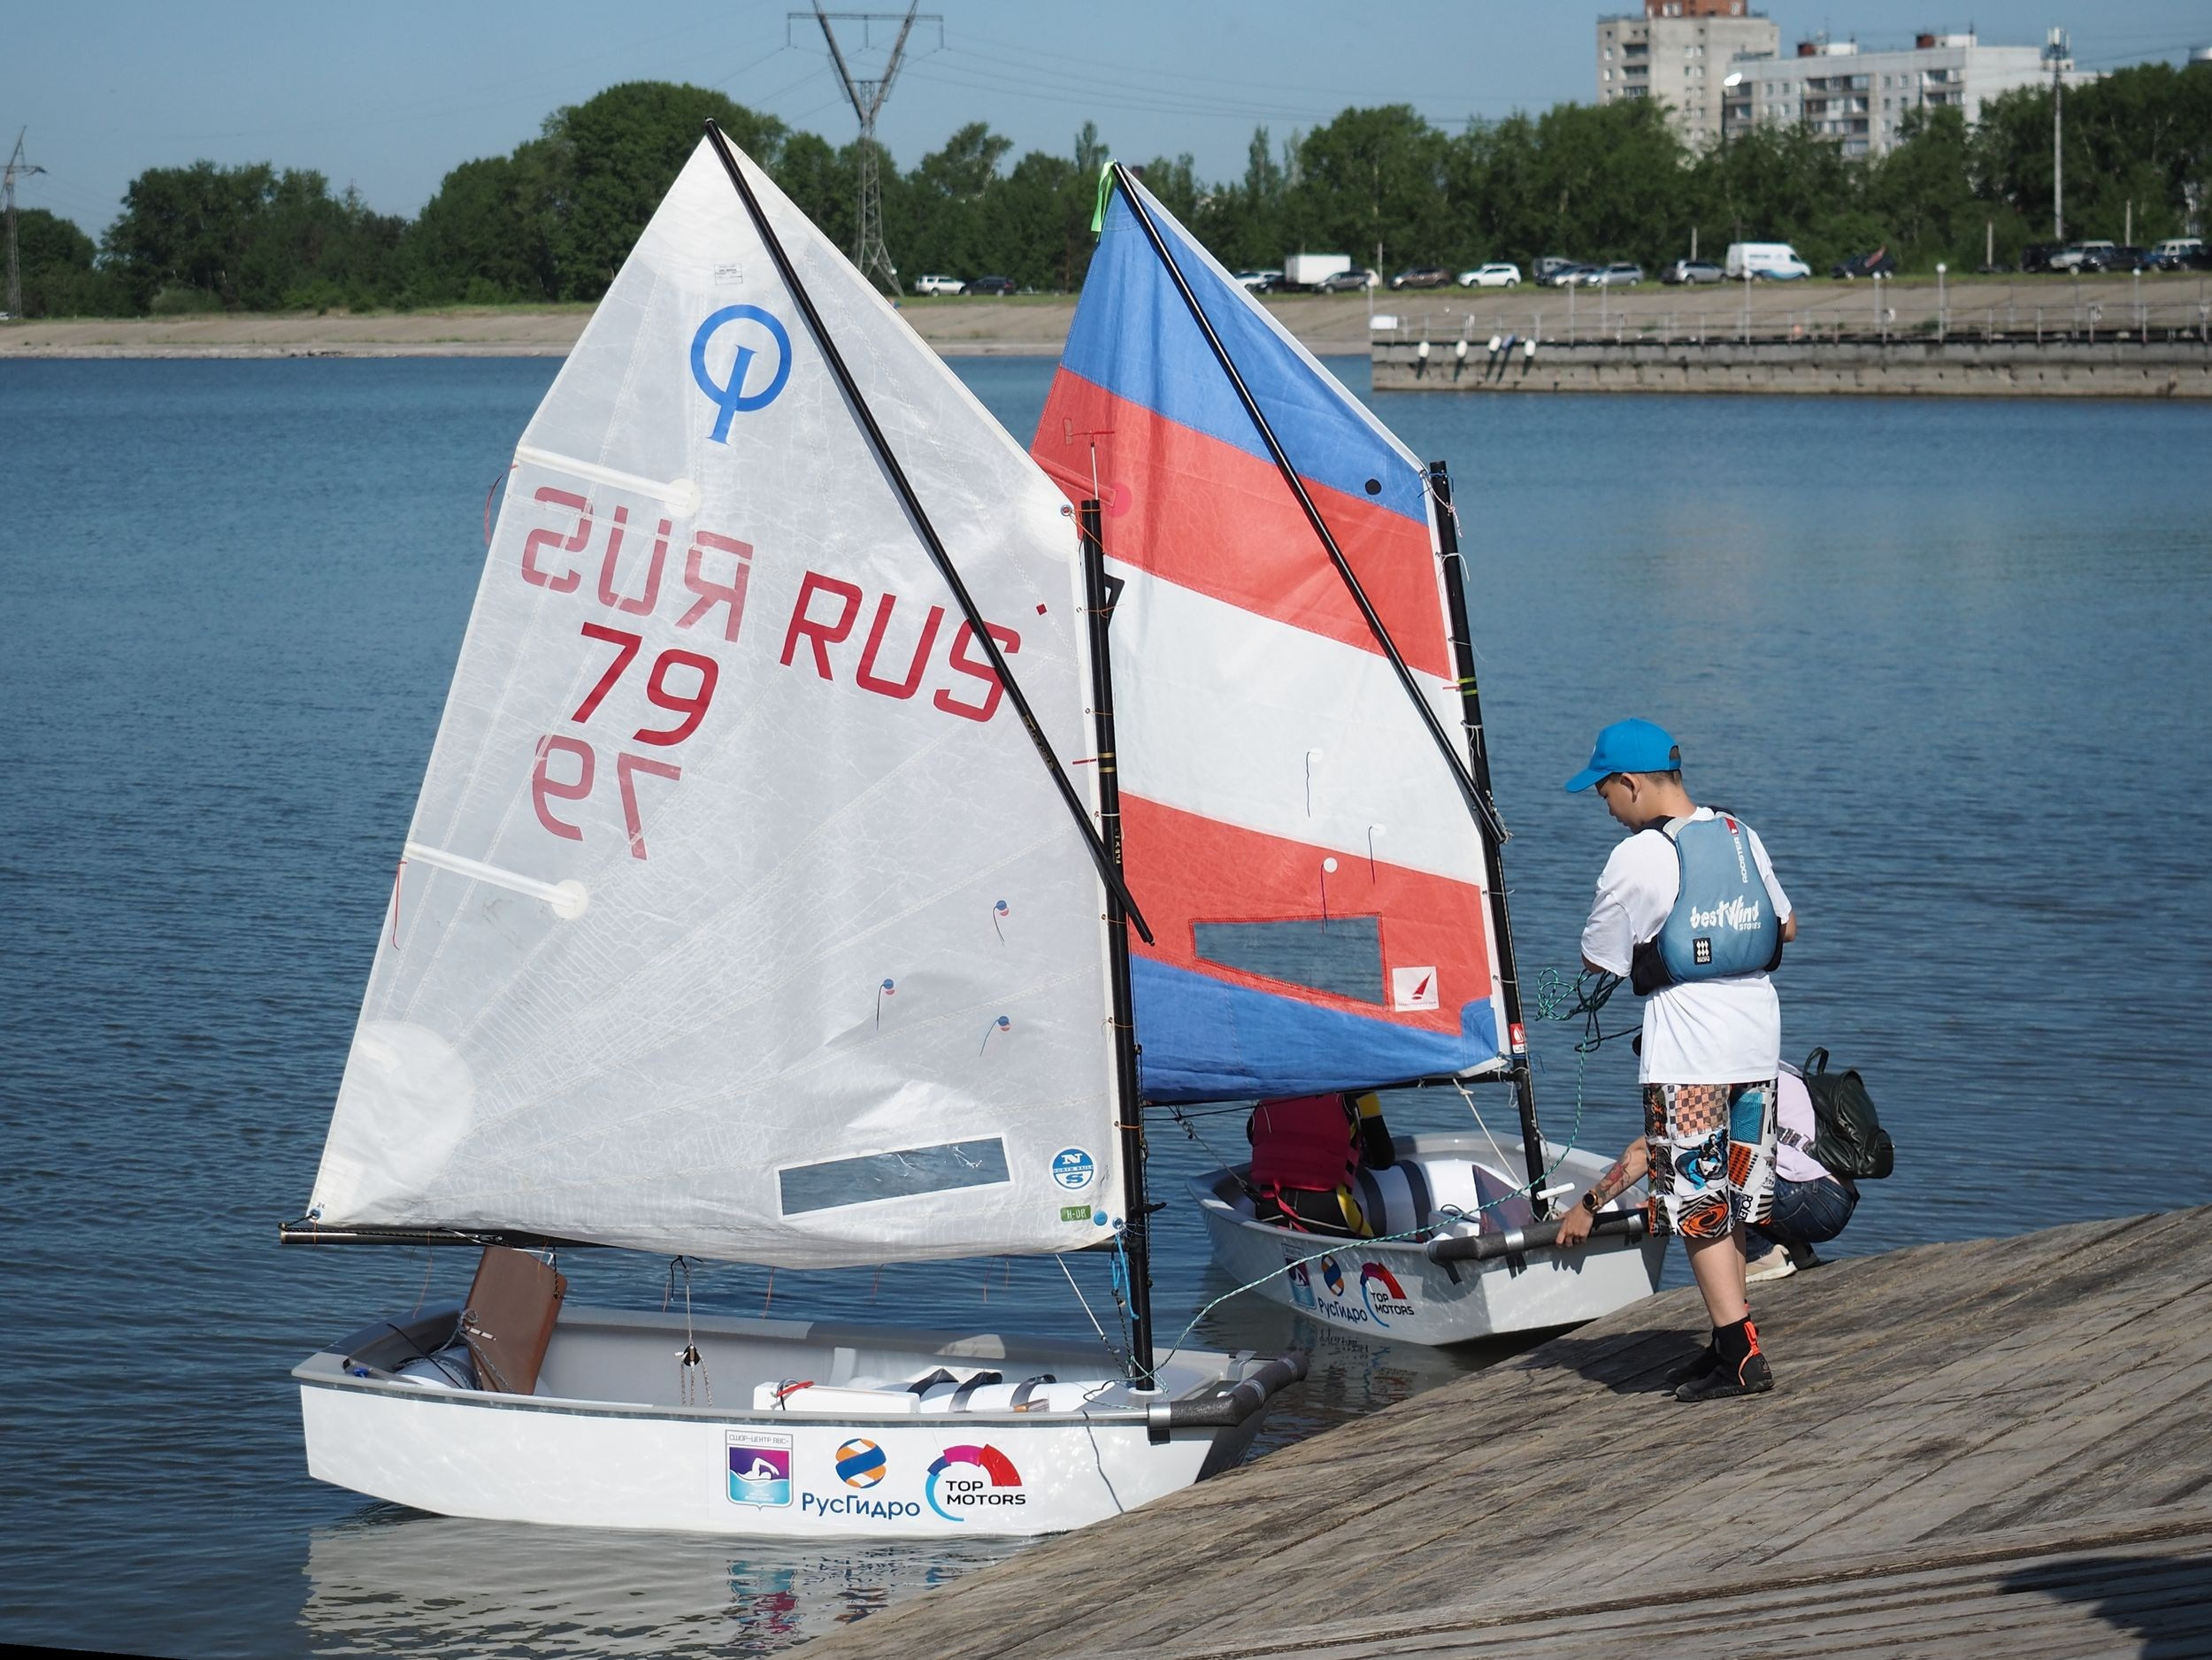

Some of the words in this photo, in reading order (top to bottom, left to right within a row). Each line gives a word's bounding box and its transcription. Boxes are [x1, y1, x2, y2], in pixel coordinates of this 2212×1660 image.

[780, 570, 1021, 723] RUS
[571, 621, 718, 746] 79
[1733, 836, 1748, 884] ROOSTER
[1317, 1297, 1368, 1324] РусГидро
[1371, 1292, 1389, 1303] TOP
[1374, 1303, 1415, 1316] MOTORS
[945, 1479, 984, 1492] TOP
[802, 1493, 921, 1520] РусГидро
[947, 1494, 1026, 1506] MOTORS
